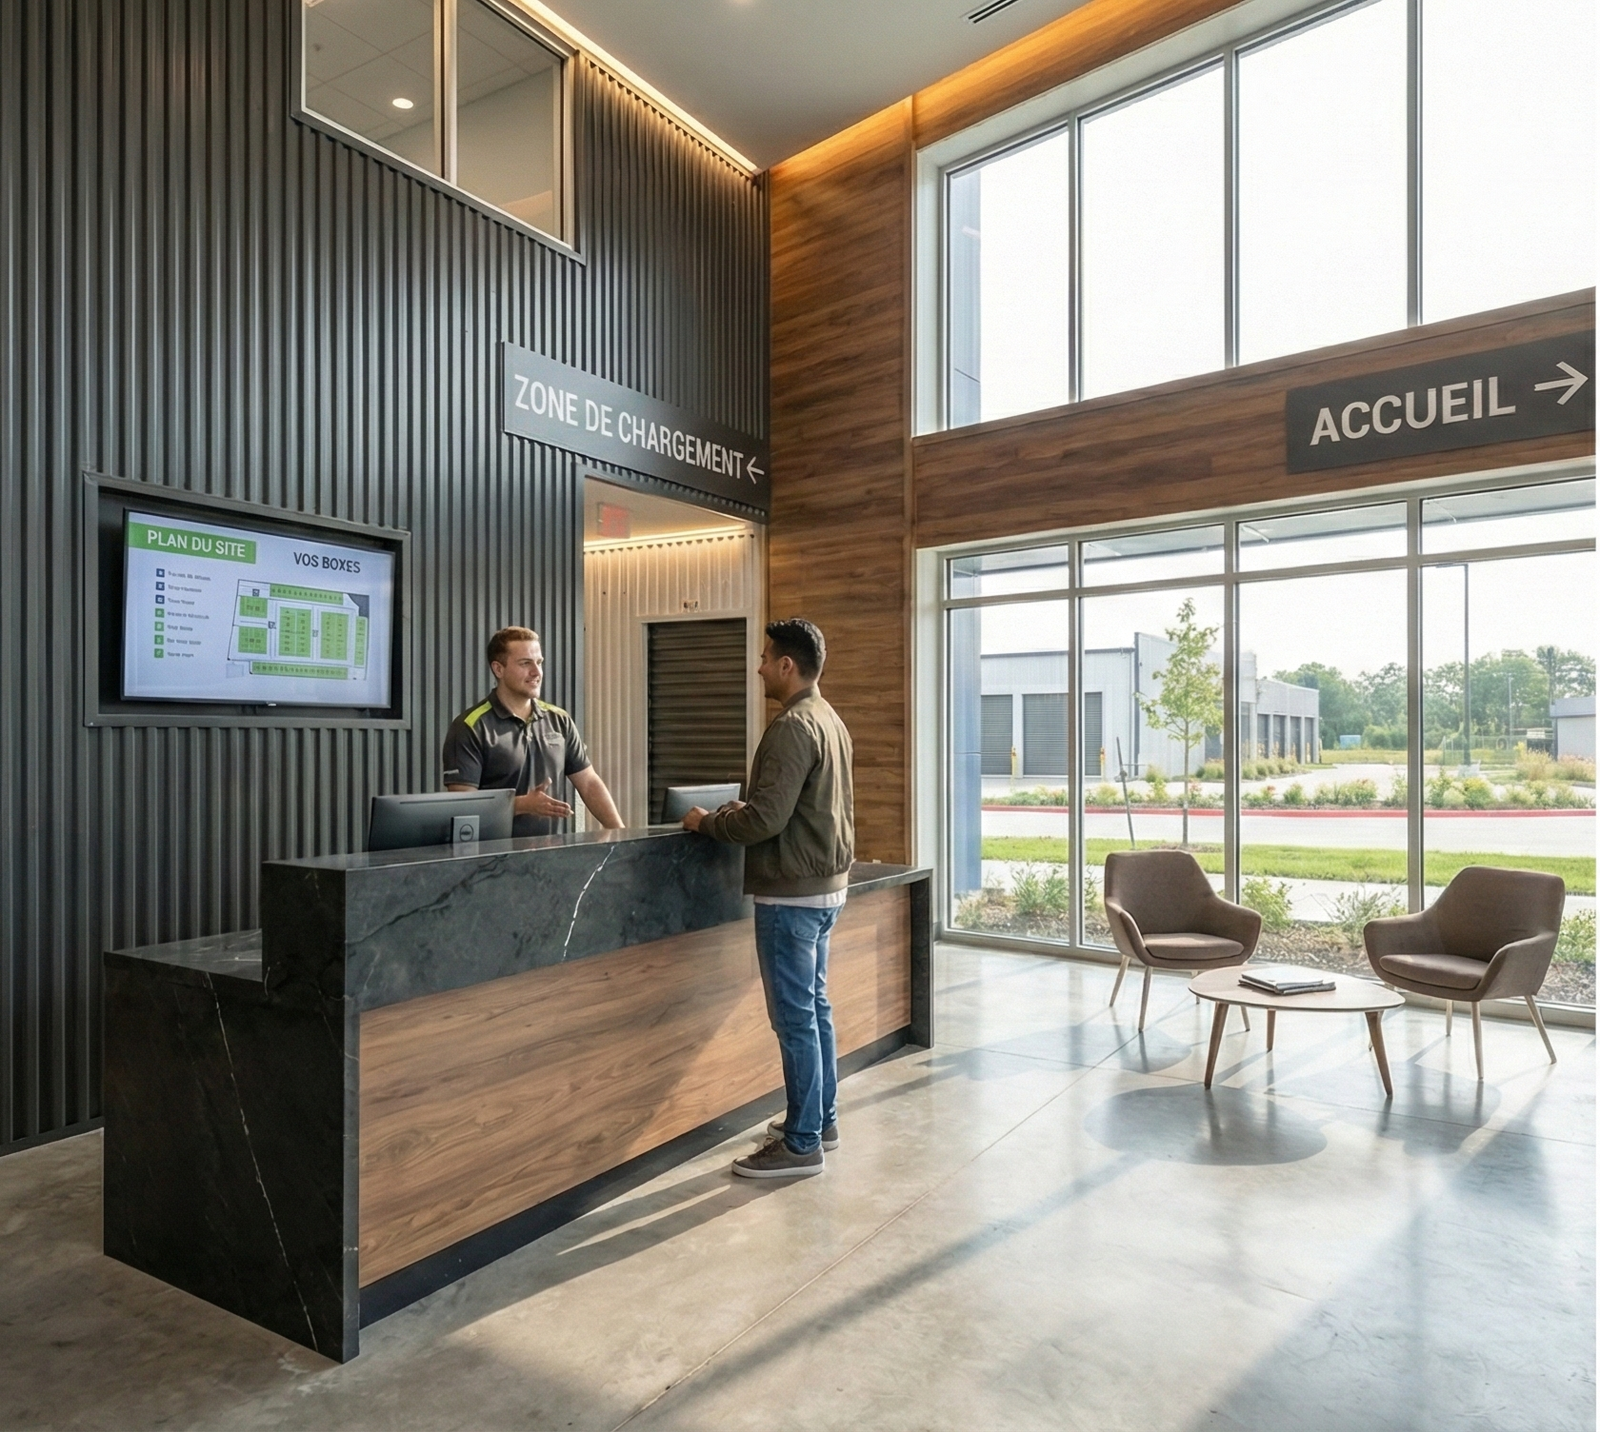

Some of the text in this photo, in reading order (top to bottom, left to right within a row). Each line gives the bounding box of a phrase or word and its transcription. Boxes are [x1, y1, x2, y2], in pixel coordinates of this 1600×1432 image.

[514, 374, 744, 479] ZONE DE CHARGEMENT
[1309, 376, 1516, 446] ACCUEIL
[147, 529, 246, 558] PLAN DU SITE
[293, 551, 361, 574] VOS BOXES
